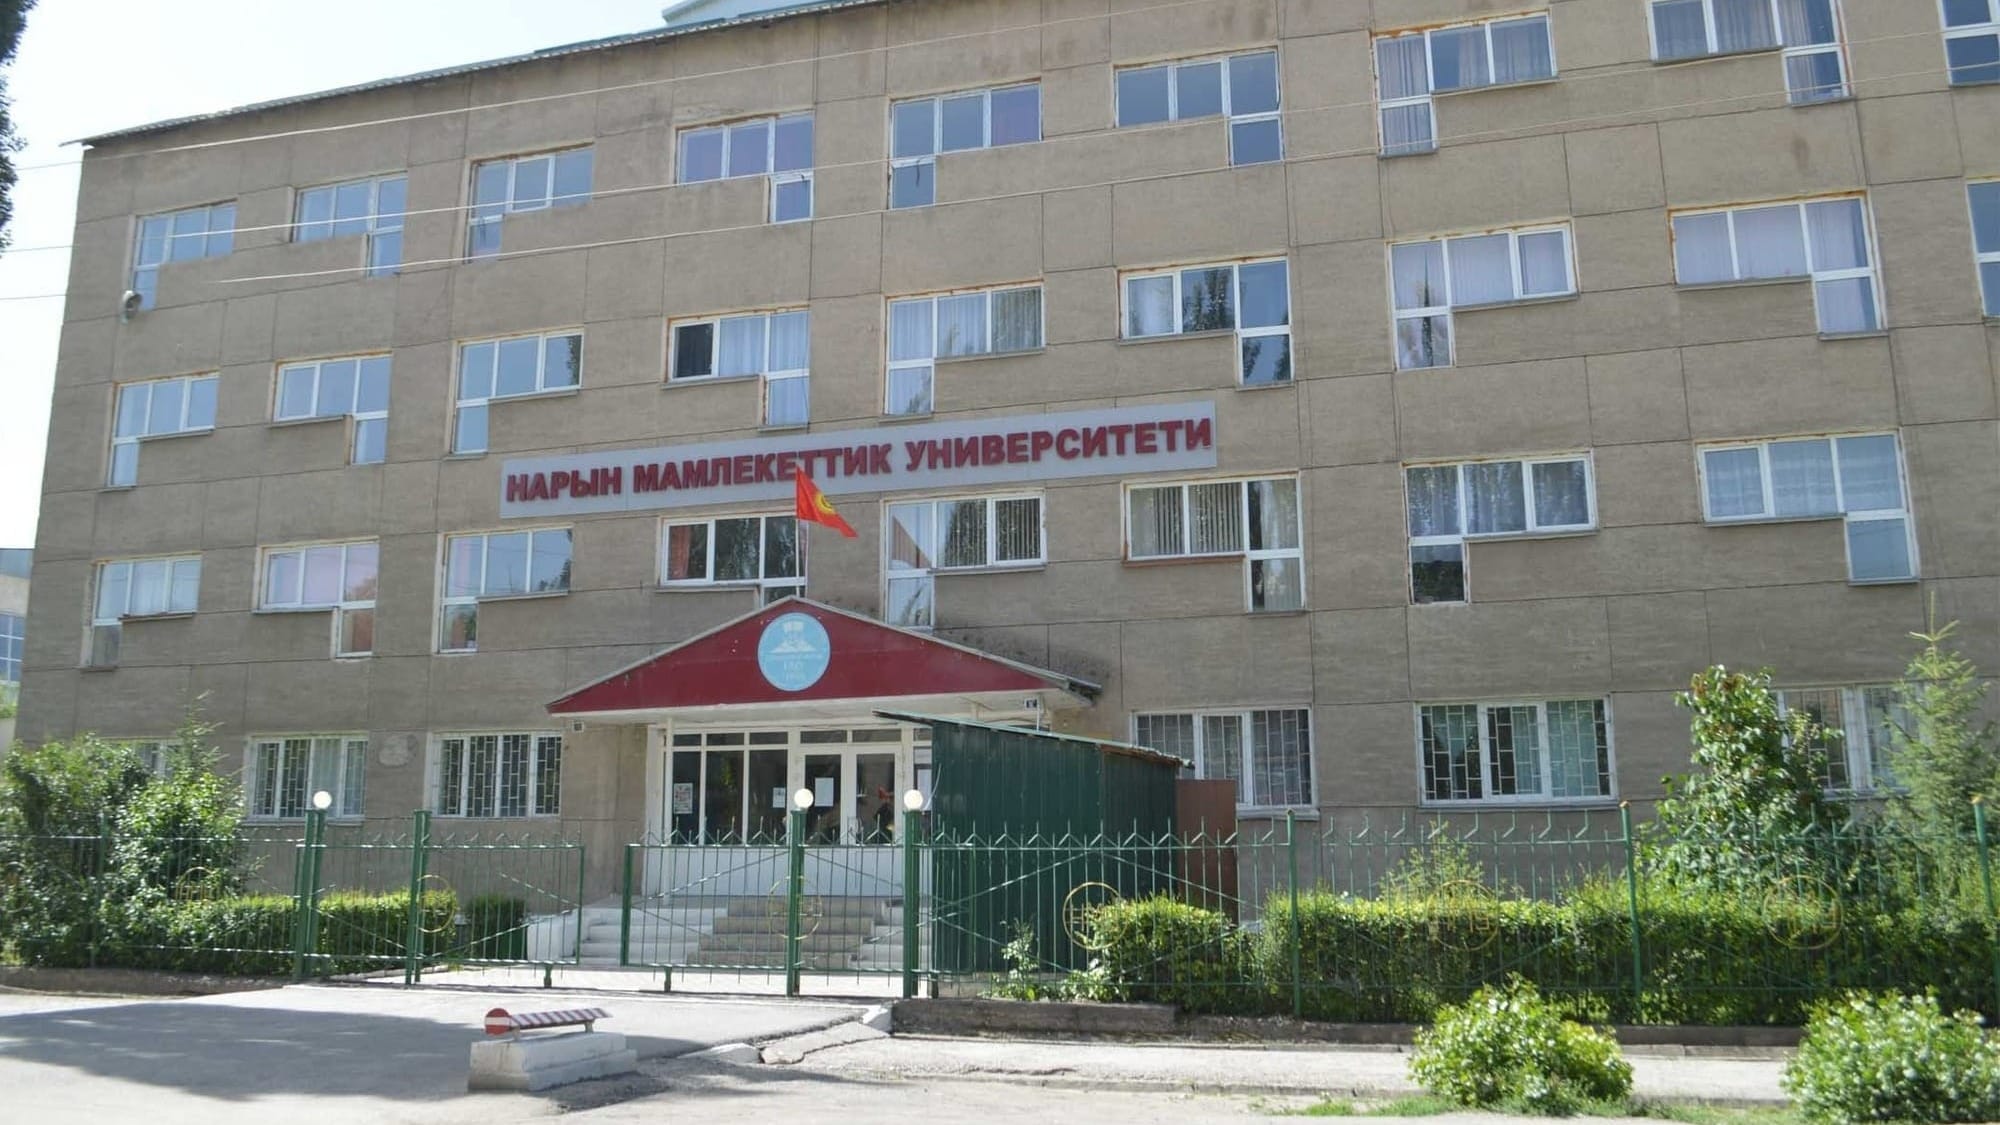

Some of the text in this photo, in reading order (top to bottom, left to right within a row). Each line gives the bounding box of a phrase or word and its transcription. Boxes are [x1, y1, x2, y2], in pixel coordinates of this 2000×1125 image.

[506, 417, 1212, 502] НАРЫН МАМЛЕКЕТТИК УНИВЕРСИТЕТИ
